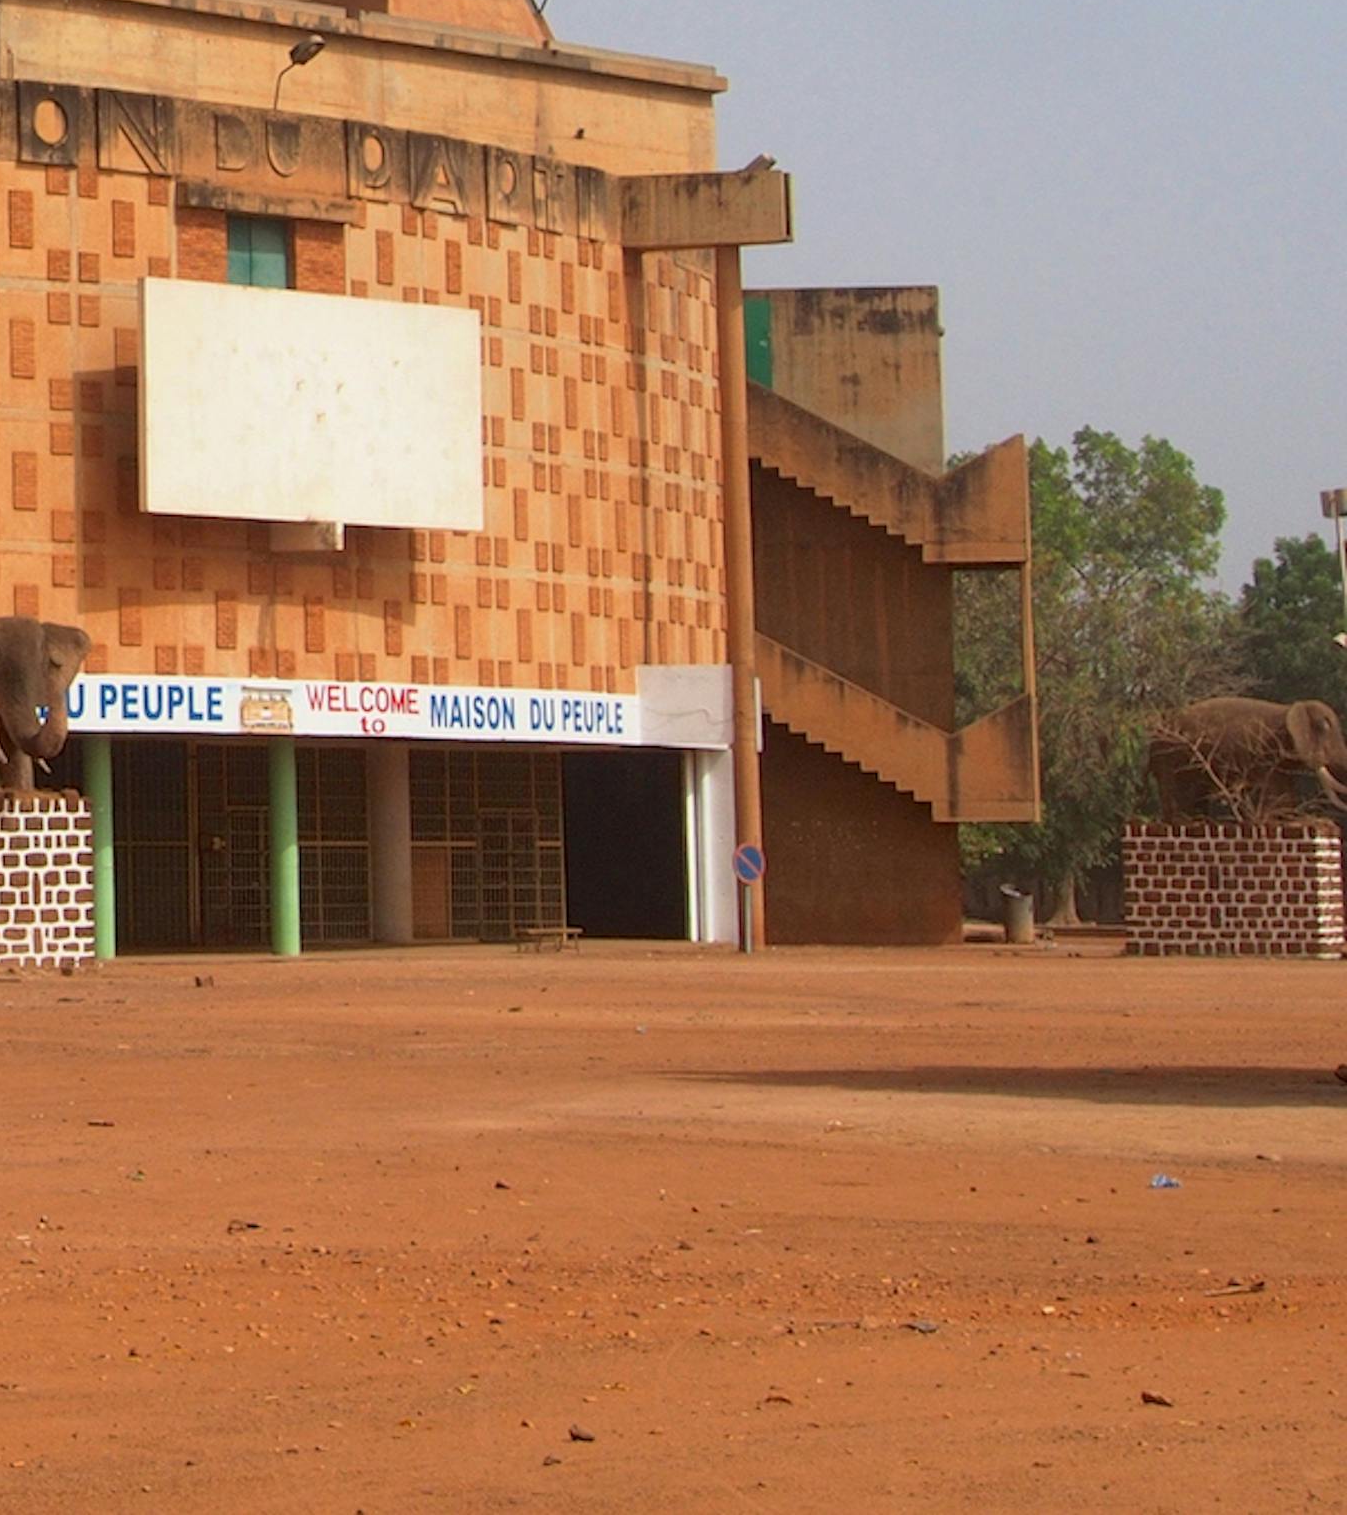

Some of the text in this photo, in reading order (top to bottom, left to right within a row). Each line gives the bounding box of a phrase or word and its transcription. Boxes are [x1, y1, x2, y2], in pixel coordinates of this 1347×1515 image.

[214, 113, 303, 178] DU
[345, 122, 606, 242] PARTI
[100, 684, 223, 721] PEUPLE
[306, 684, 420, 715] WELCOME
[430, 694, 623, 734] MAISON DU PEUPLE
[360, 716, 386, 734] to
